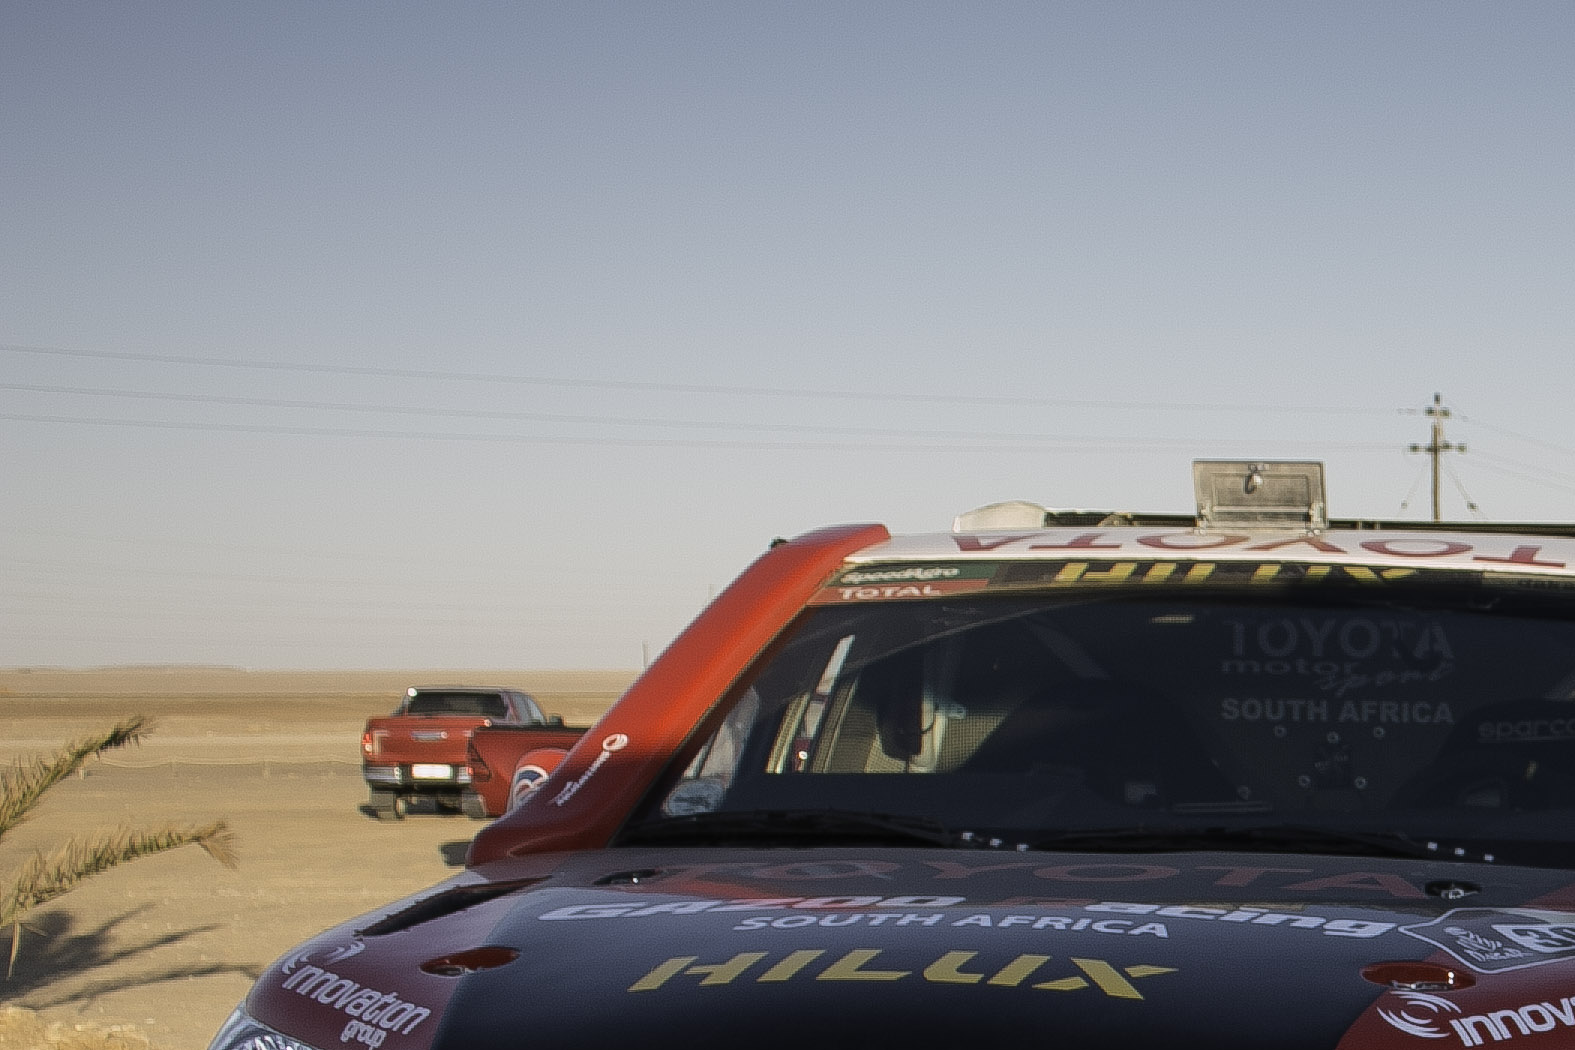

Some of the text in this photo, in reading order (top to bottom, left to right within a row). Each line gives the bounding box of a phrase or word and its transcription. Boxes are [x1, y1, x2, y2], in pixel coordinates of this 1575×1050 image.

[841, 584, 941, 600] TOTAL
[1222, 617, 1455, 660] TOYOTA
[1221, 658, 1358, 675] motor
[1221, 698, 1455, 724] SOUTH AFRICA
[660, 860, 1427, 898] TOYOTA
[537, 894, 967, 922] GAZOO
[732, 912, 1169, 939] SOUTH AFRICA
[626, 948, 1180, 1000] HILUX
[281, 962, 431, 1036] innovation
